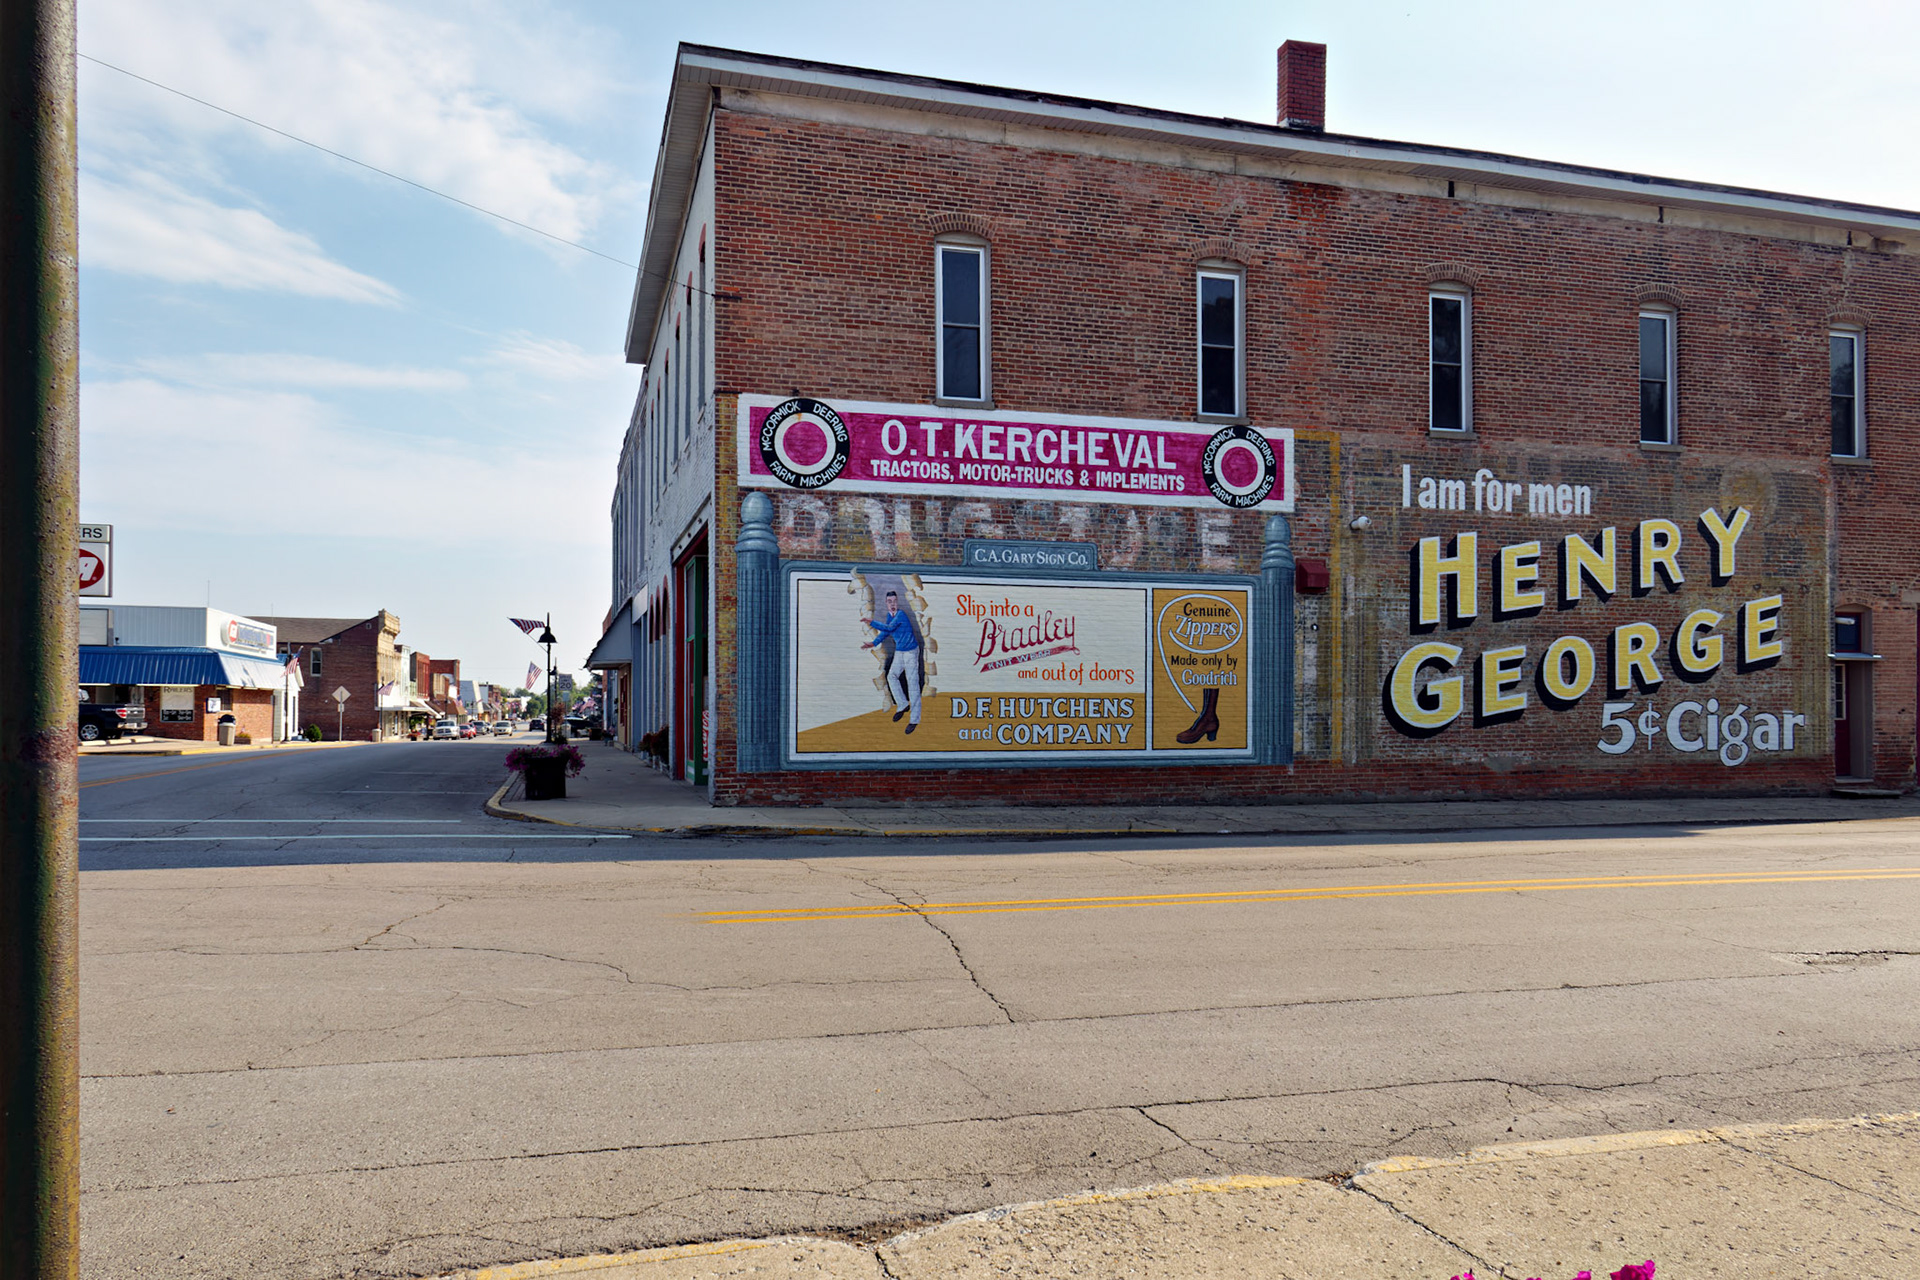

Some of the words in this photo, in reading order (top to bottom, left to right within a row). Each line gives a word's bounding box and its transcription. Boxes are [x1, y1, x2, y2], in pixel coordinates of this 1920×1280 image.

[812, 402, 849, 443] DEERING
[1245, 431, 1275, 467] DEERING
[769, 460, 797, 483] FARM
[799, 453, 848, 487] MACHINES
[870, 459, 955, 482] TRACTORS,
[959, 463, 1074, 486] MOTOR-TRUCKS
[1079, 469, 1090, 487] &
[1096, 471, 1185, 491] IMPLEMENTS
[1210, 483, 1232, 504] FARM
[1235, 474, 1275, 507] MACHINES
[1401, 464, 1411, 508] I
[1417, 476, 1466, 511] am
[1471, 469, 1522, 513] for
[1528, 481, 1592, 516] men
[1037, 551, 1066, 566] SIGN
[1411, 505, 1751, 632] HENRY
[956, 594, 986, 623] Slip
[989, 598, 1023, 618] into
[1024, 604, 1034, 618] a
[1183, 602, 1231, 618] Genuine
[973, 610, 1077, 666] Bradley
[987, 657, 1013, 670] KNIT
[1016, 649, 1051, 664] WEAR
[1018, 667, 1038, 680] and
[1042, 662, 1065, 681] out
[1068, 662, 1084, 686] of
[1089, 662, 1135, 685] doors
[1171, 654, 1198, 666] Made
[1201, 654, 1221, 670] only
[1225, 654, 1238, 670] by
[1384, 594, 1783, 735] GEORGE
[1181, 669, 1238, 686] Goodrich
[998, 697, 1136, 719] HUTCHENS
[958, 724, 993, 741] and
[996, 723, 1134, 745] COMPANY
[1666, 698, 1806, 767] Cigar
